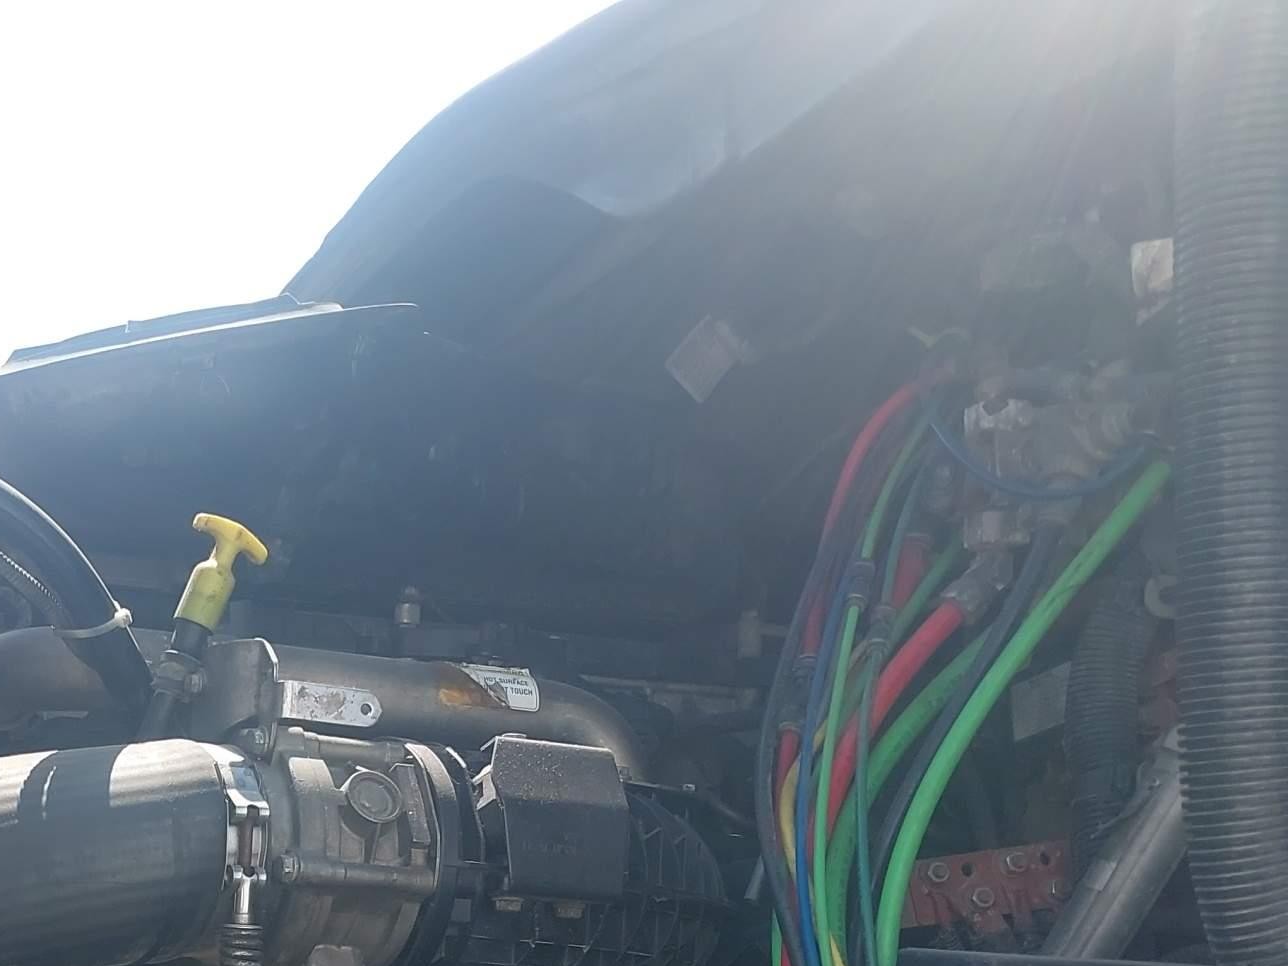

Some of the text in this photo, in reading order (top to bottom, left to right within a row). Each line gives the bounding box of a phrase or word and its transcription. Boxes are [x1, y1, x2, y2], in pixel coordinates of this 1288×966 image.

[484, 676, 528, 686] HOT SURFACE
[511, 687, 533, 696] TOUCH
